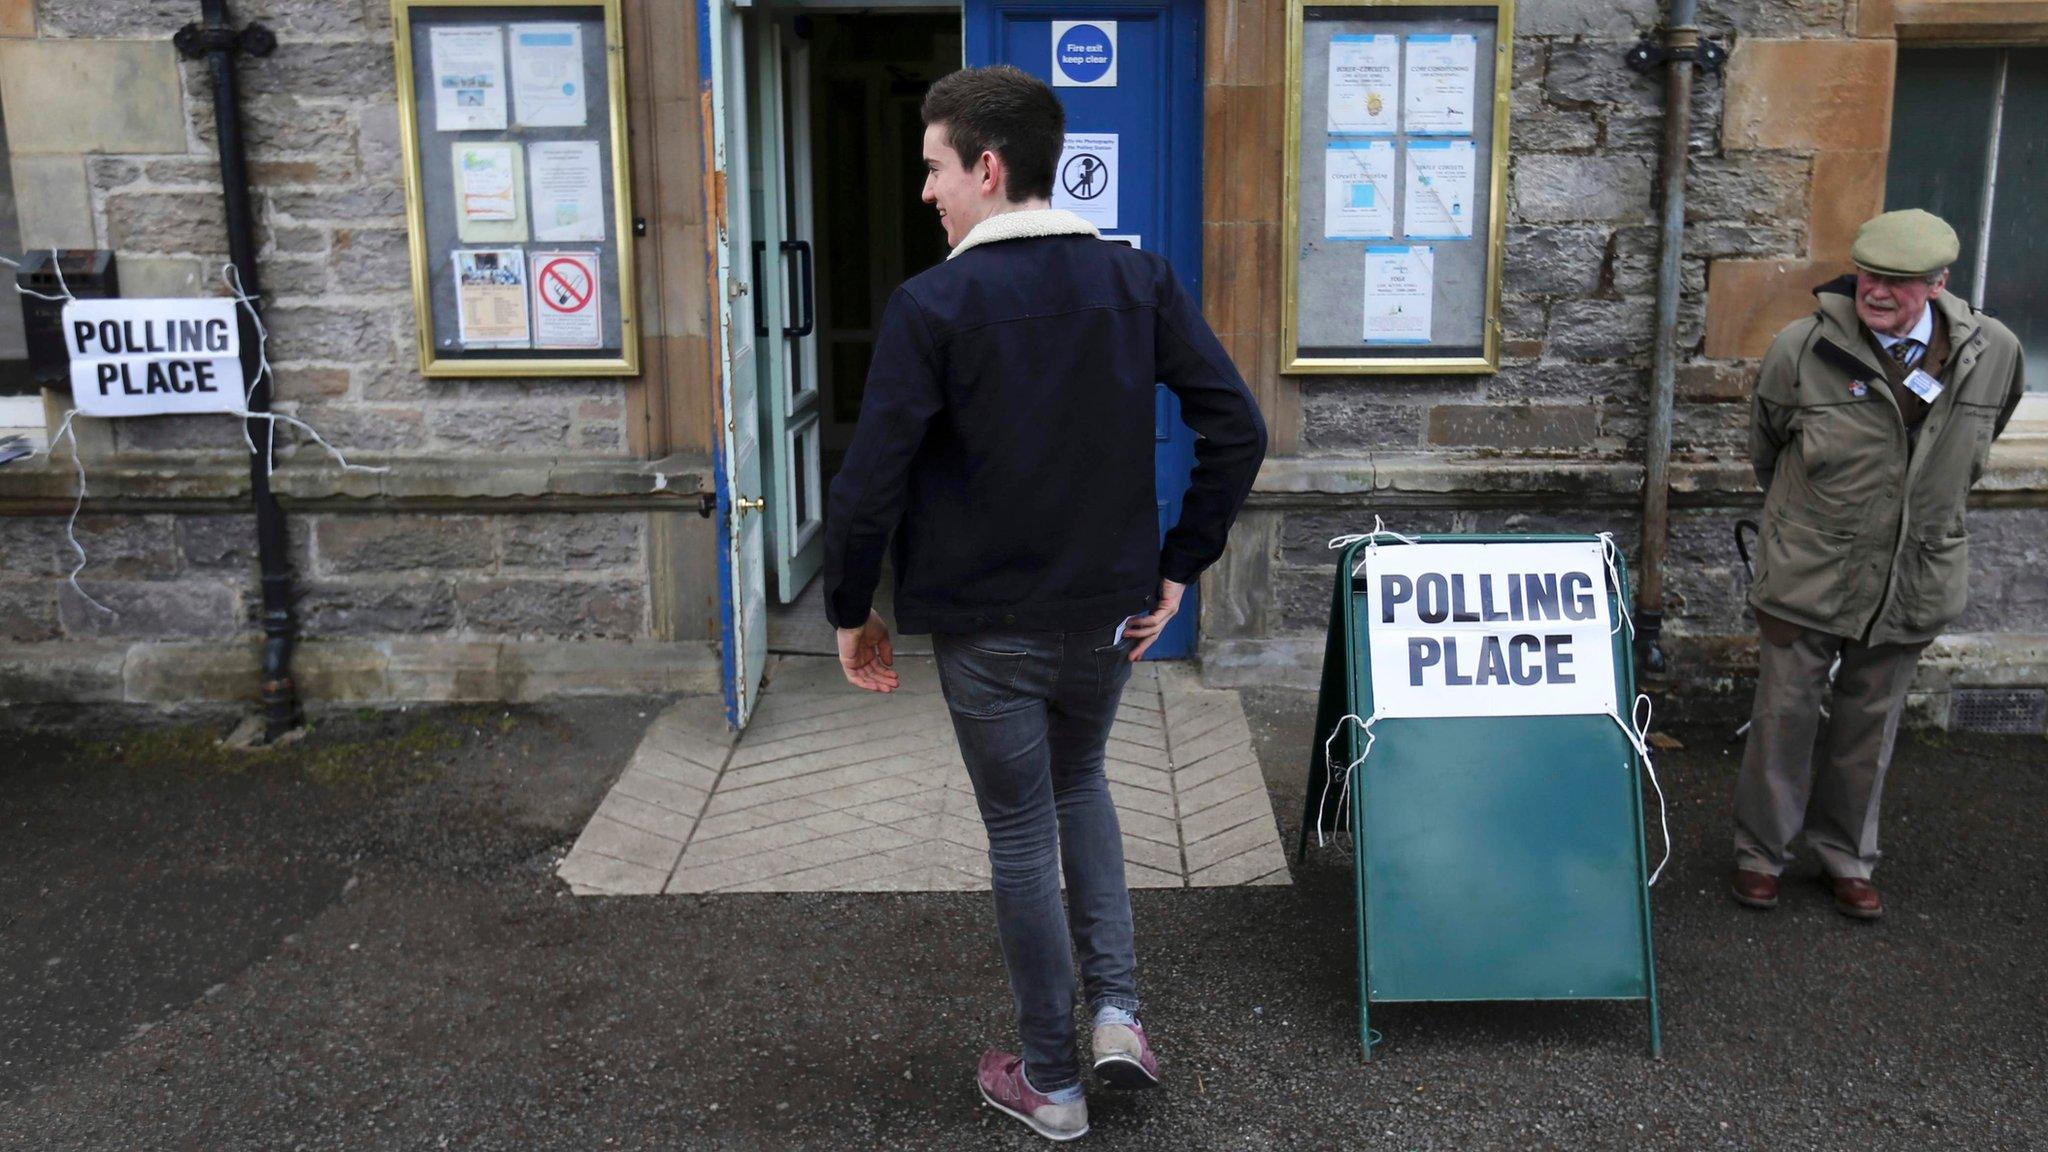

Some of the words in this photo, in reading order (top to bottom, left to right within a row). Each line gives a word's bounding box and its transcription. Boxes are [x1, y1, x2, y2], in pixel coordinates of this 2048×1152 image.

[1062, 55, 1084, 65] keep
[1085, 55, 1107, 64] clear
[1067, 43, 1085, 52] Fire
[1086, 43, 1103, 52] exit
[74, 319, 229, 354] POLLING
[97, 360, 218, 395] PLACE
[1380, 571, 1597, 624] POLLING
[1408, 633, 1576, 686] PLACE
